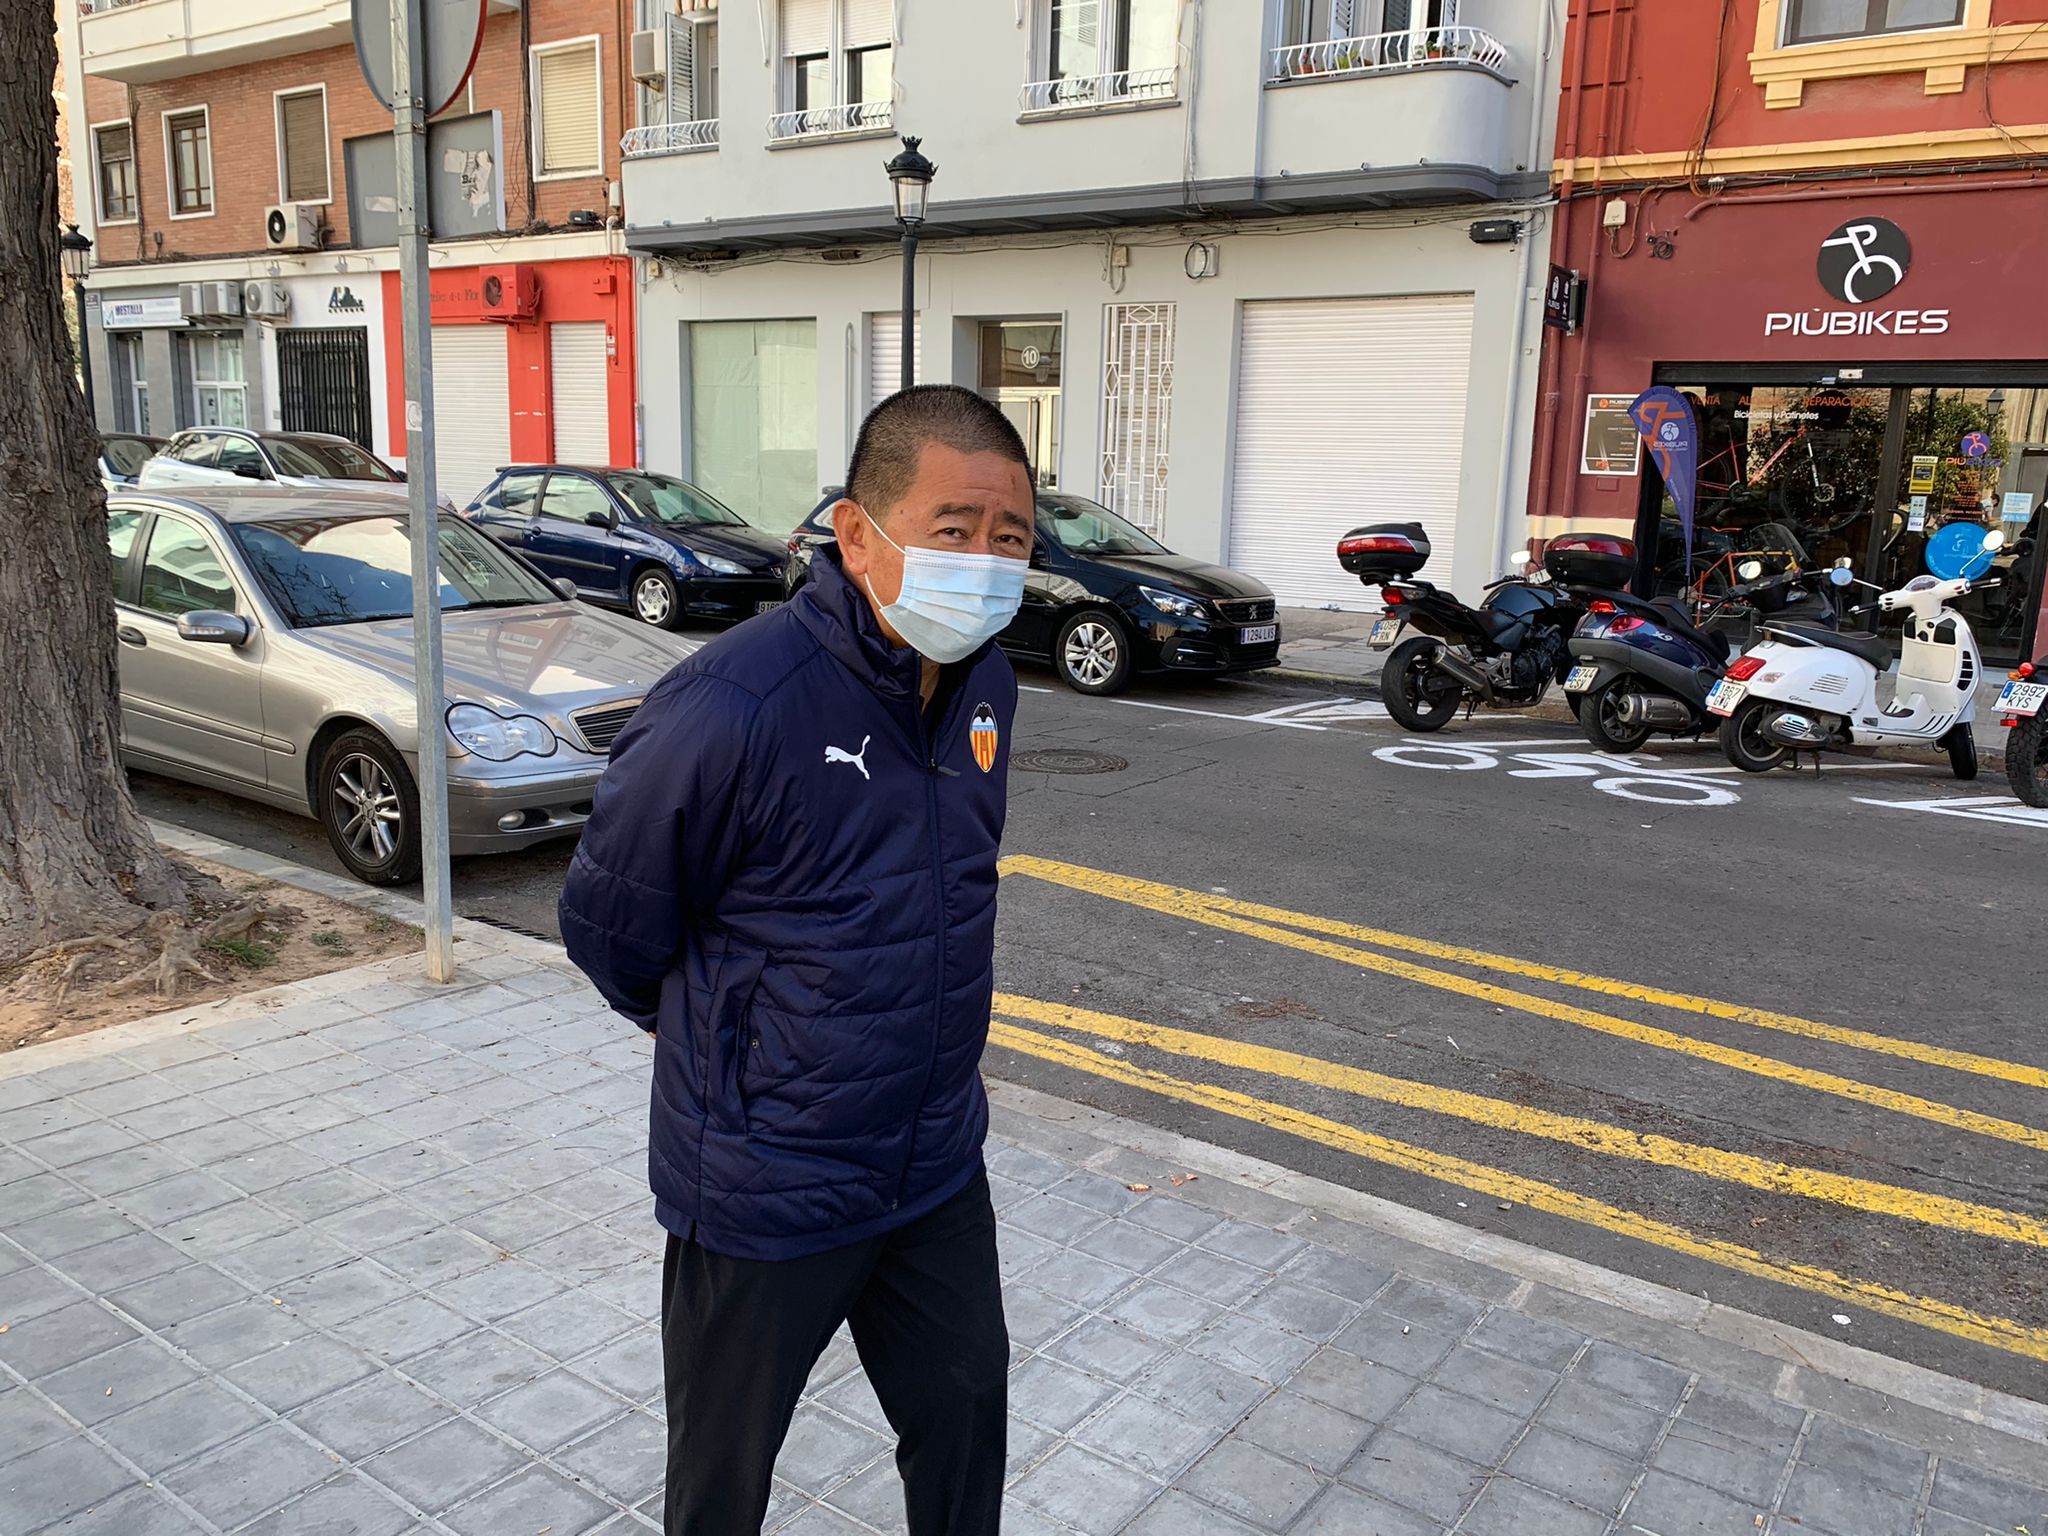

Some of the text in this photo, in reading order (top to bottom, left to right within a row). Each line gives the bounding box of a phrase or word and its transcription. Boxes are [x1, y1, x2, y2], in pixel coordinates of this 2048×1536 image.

[1024, 350, 1037, 364] 10
[1734, 410, 1771, 420] Bicicletas
[1781, 411, 1819, 420] Patinetes
[1247, 628, 1262, 641] 1294
[2013, 684, 2046, 698] 2992
[2006, 696, 2032, 708] KYS
